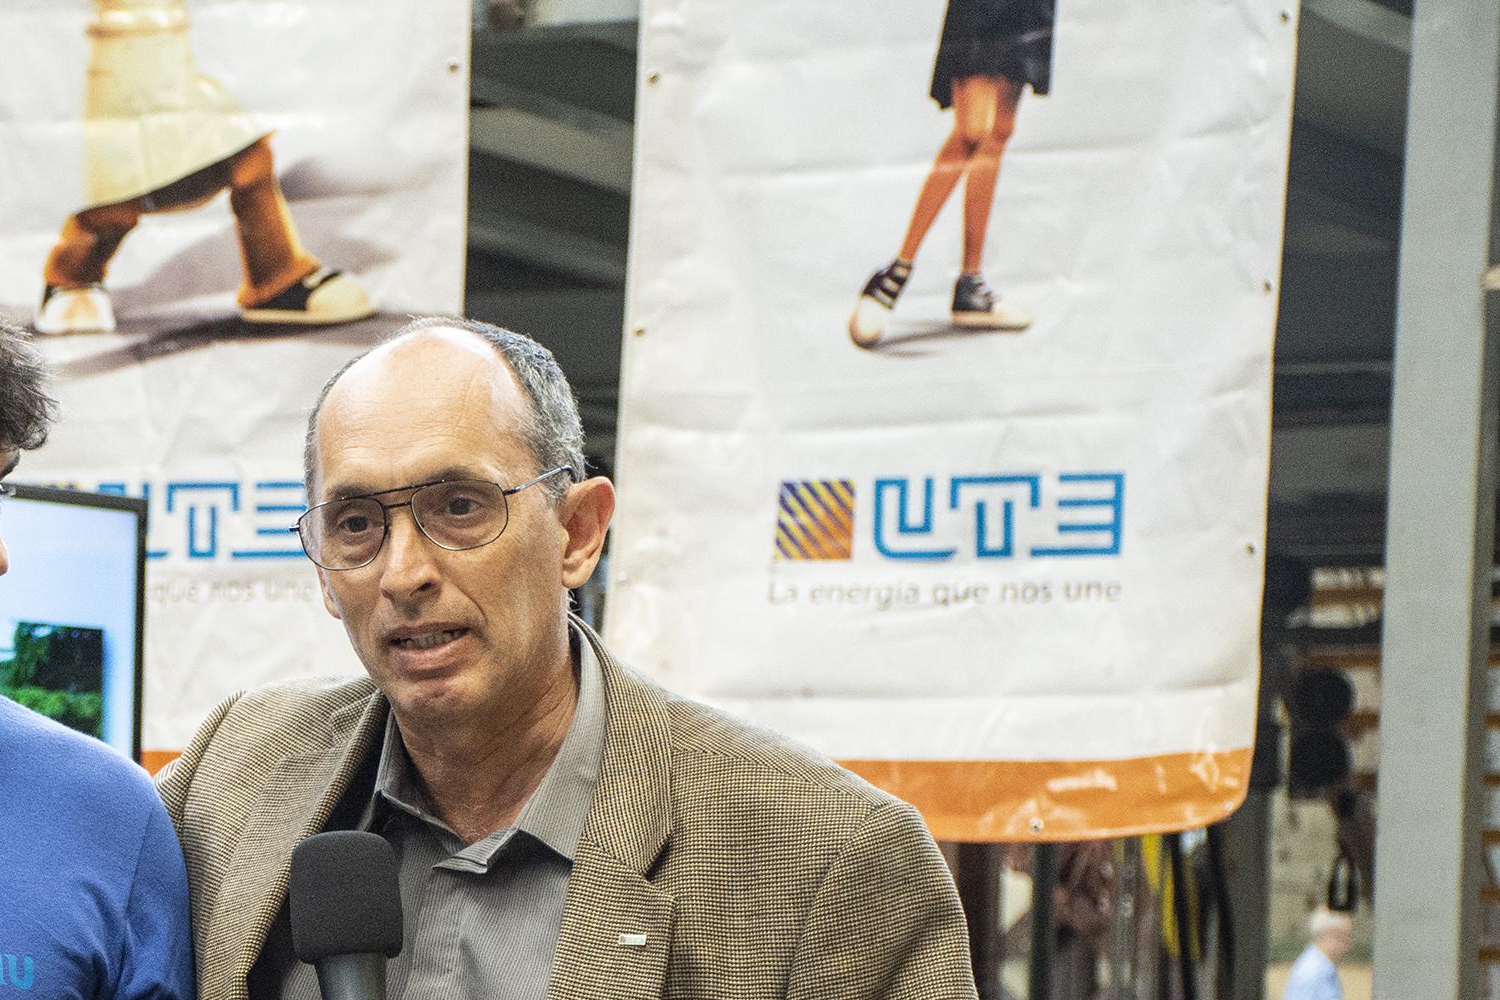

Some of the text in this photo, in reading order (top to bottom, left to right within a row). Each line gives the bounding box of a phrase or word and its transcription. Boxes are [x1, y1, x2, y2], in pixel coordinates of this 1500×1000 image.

[767, 579, 1123, 611] La energía que nos une
